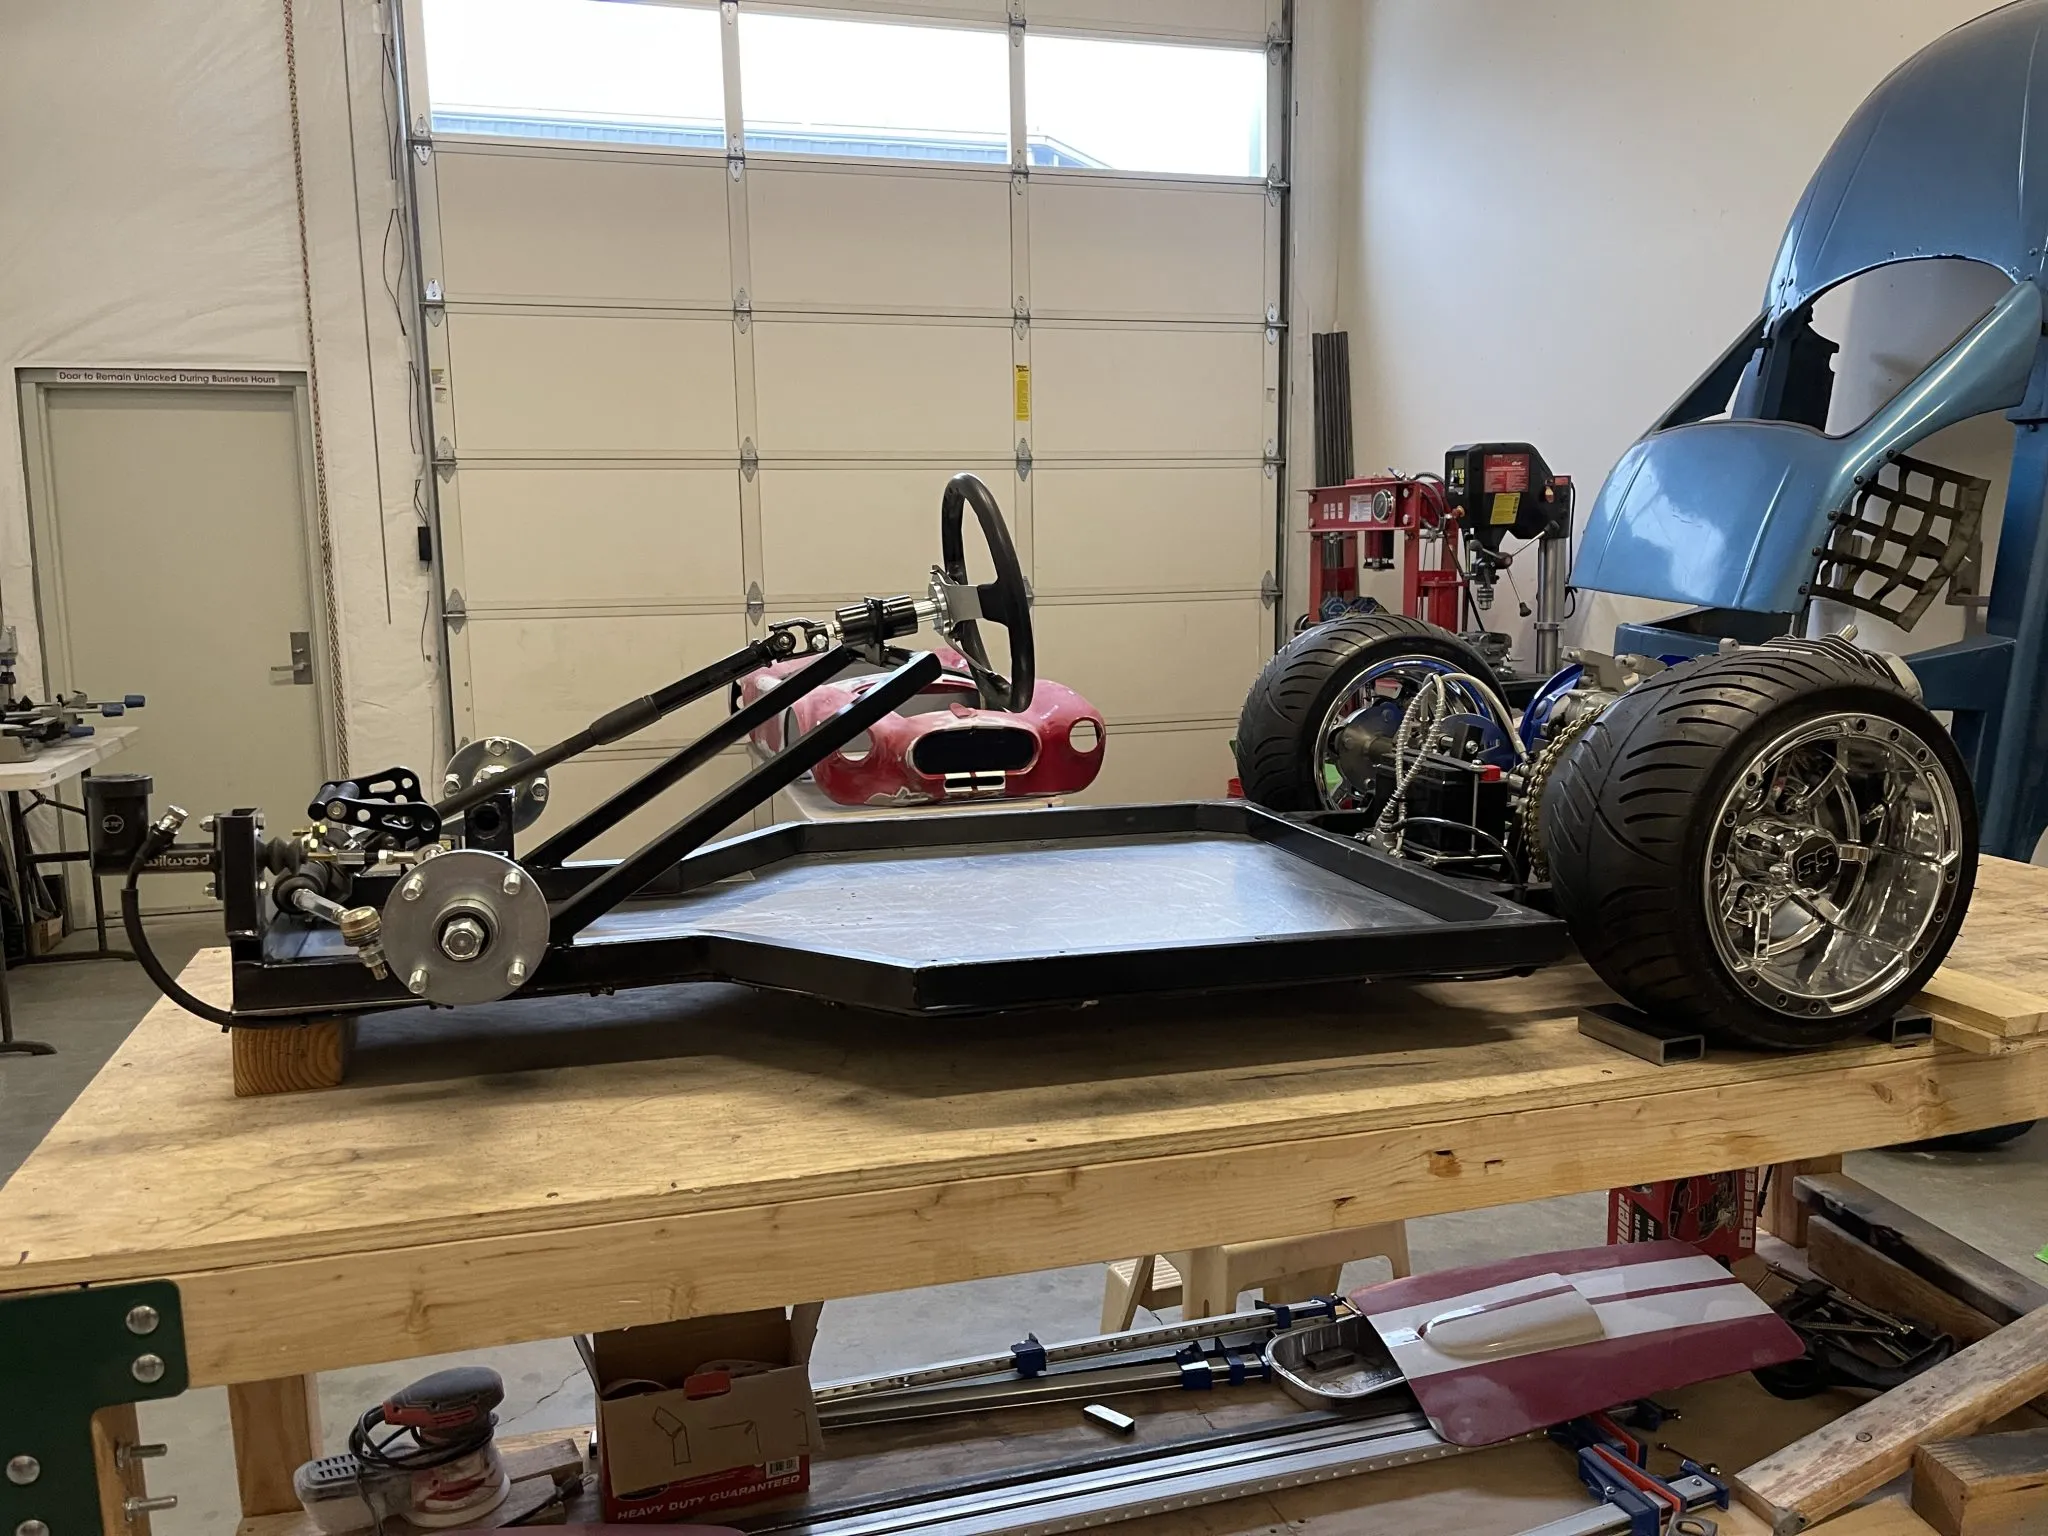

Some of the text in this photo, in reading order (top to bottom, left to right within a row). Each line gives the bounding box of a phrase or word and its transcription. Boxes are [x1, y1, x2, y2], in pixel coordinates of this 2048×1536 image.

[59, 371, 276, 384] Door to Remain Unlocked During Business Hours
[1647, 1218, 1655, 1237] SAW
[617, 1504, 664, 1520] HEAVY
[668, 1495, 705, 1511] DUTY
[710, 1474, 801, 1501] GUARANTEED
